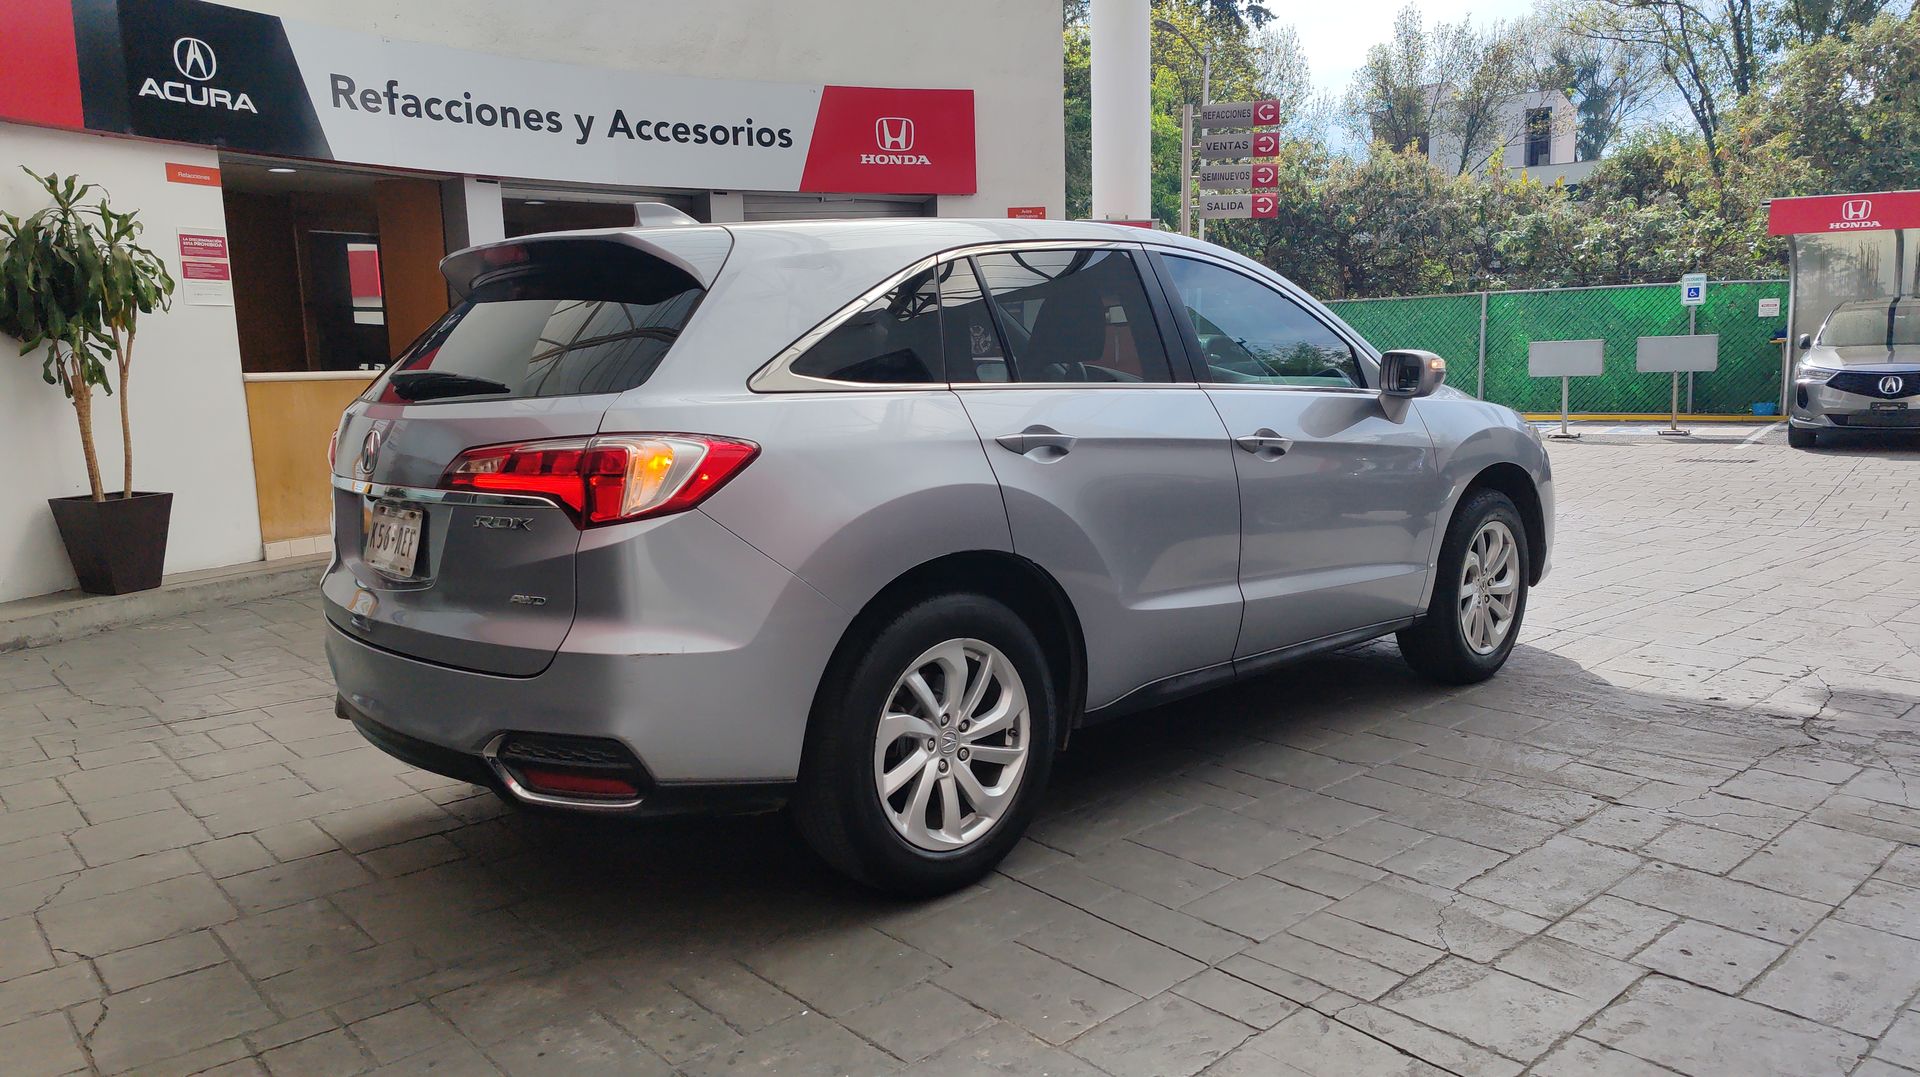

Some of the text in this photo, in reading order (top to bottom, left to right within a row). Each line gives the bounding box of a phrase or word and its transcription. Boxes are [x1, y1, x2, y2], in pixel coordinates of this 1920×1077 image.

[138, 77, 258, 114] ACURA
[329, 73, 794, 149] Refacciones y Accesorios
[1202, 109, 1252, 120] REFACCIONES
[1206, 141, 1249, 151] VENTAS
[860, 154, 932, 165] HONDA
[1201, 171, 1250, 182] SEMINUEVOS
[1206, 201, 1245, 211] SALIDA
[1829, 220, 1882, 229] HONDA
[473, 515, 536, 531] RDX
[509, 594, 546, 605] AWD
